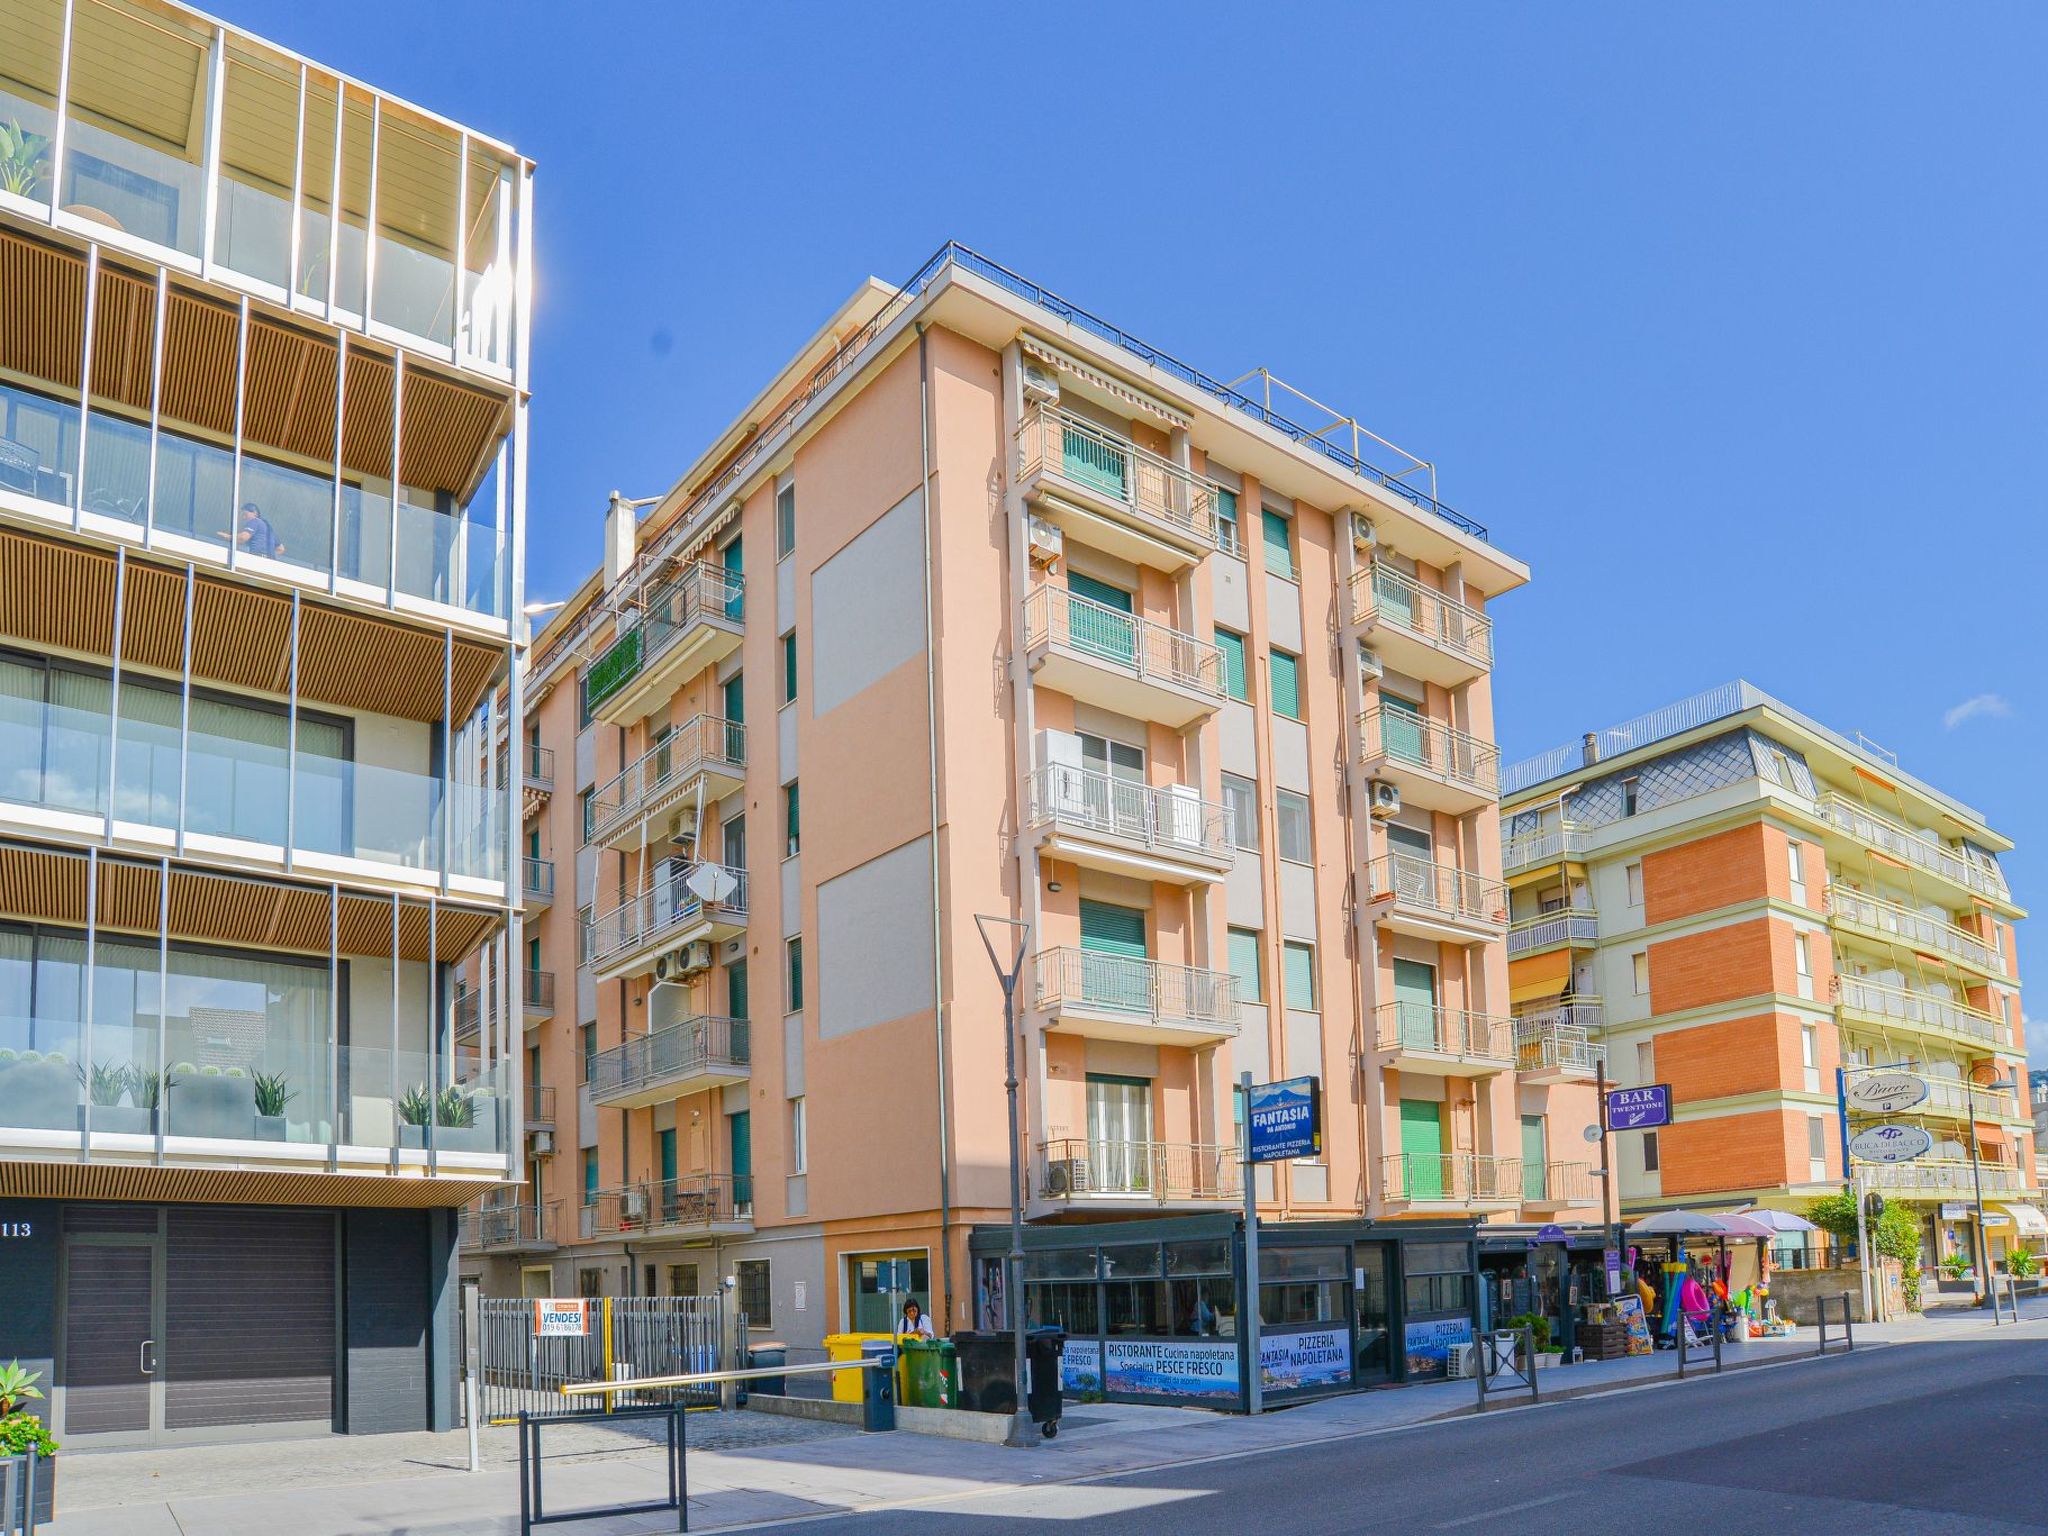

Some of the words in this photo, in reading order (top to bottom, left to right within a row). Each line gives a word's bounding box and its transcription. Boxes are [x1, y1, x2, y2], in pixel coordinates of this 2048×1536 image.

[1620, 1090, 1654, 1104] BAR
[1612, 1102, 1663, 1113] TWENTYONE
[1253, 1106, 1309, 1127] FANTASIA
[1275, 1123, 1296, 1132] ANTONIO
[1253, 1142, 1286, 1153] RISTORANTE
[1286, 1139, 1311, 1149] PIZZERIA
[1892, 1139, 1925, 1148] BACCO
[1263, 1148, 1300, 1159] NAPOLETANA
[2, 1222, 31, 1237] 113
[543, 1313, 581, 1323] VENDESI
[1436, 1322, 1463, 1336] PIZZERIA
[1298, 1334, 1335, 1350] PIZZERIA
[1070, 1346, 1099, 1355] napoletana
[1108, 1344, 1162, 1359] RISTORANTE
[1164, 1347, 1189, 1360] Cucina
[1189, 1348, 1235, 1361] napoletana
[1290, 1348, 1344, 1366] NAPOLETANA
[1067, 1355, 1092, 1366] FRESCO
[1156, 1360, 1184, 1374] PESCE
[1186, 1361, 1223, 1376] FRESCO
